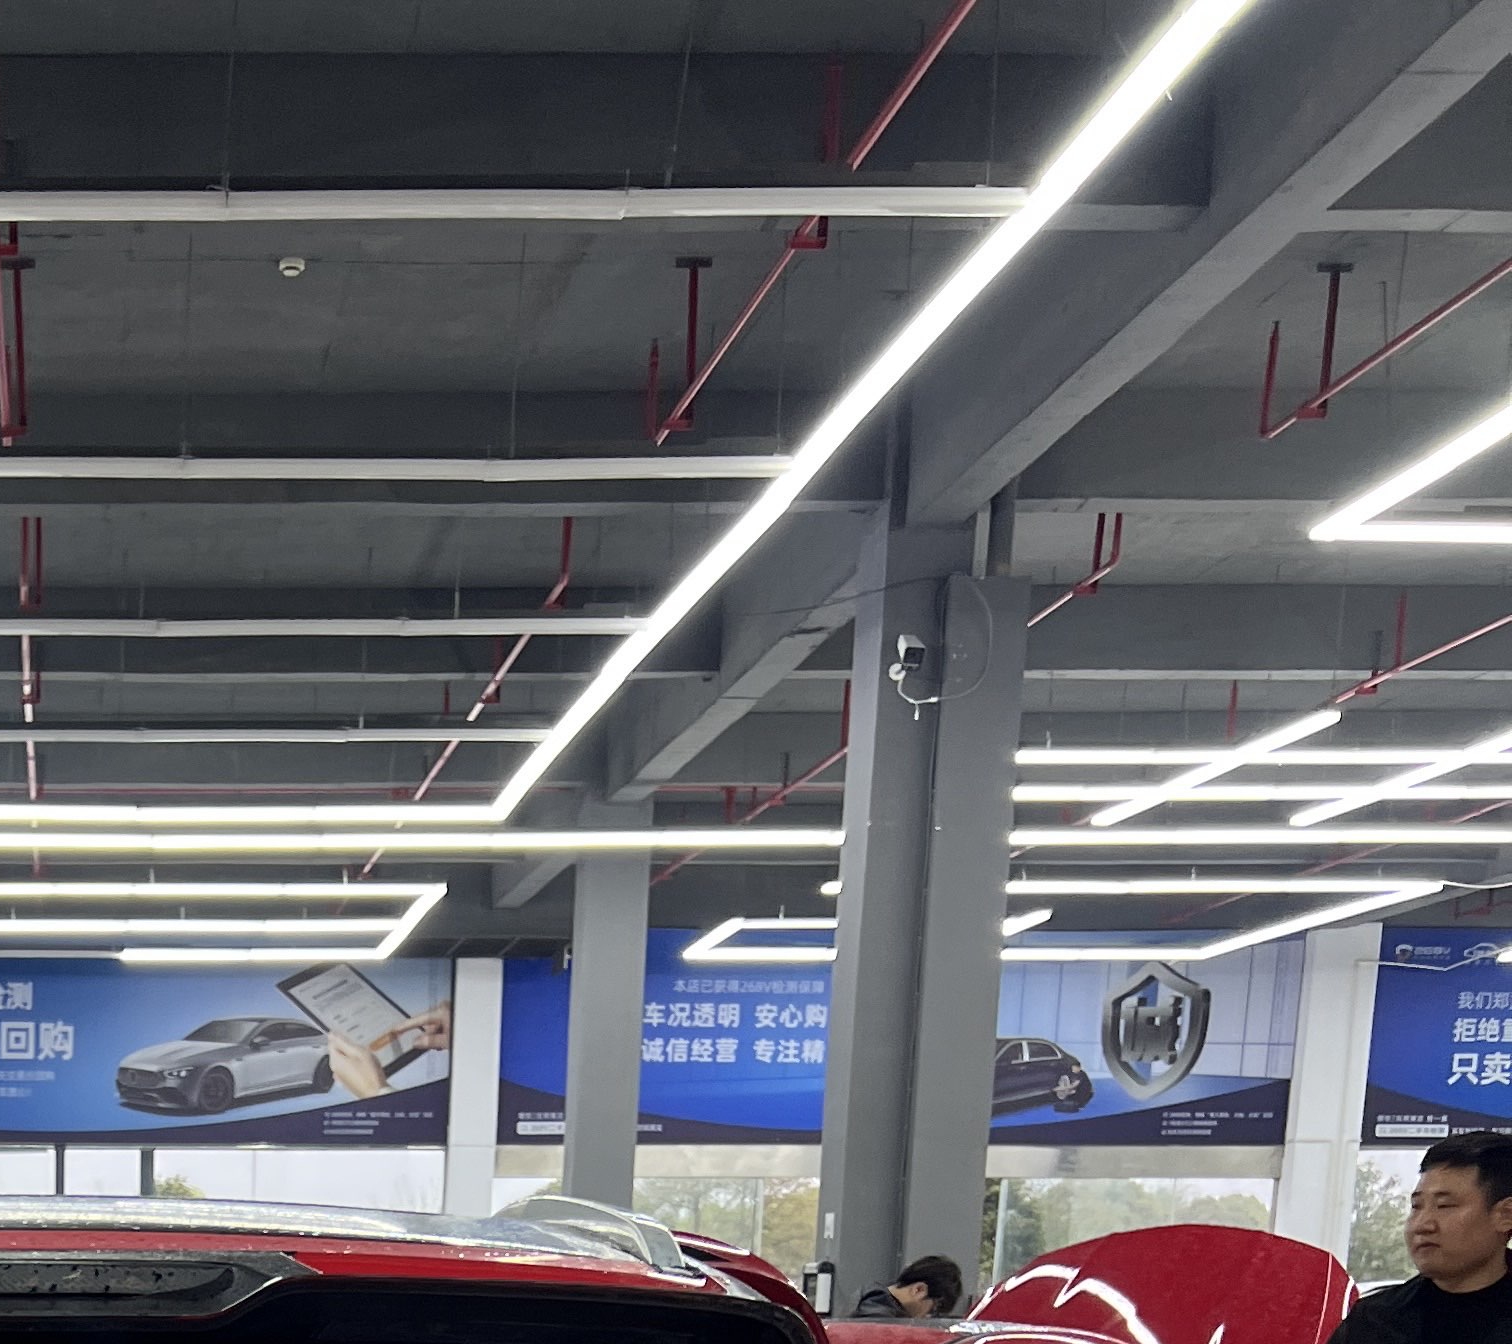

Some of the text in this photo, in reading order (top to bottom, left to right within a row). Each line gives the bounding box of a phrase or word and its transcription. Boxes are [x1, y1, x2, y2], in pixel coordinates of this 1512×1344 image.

[1458, 991, 1512, 1010] 我们郑
[643, 1002, 828, 1029] 车况透明 安心购
[641, 1037, 739, 1063] 诚信经营
